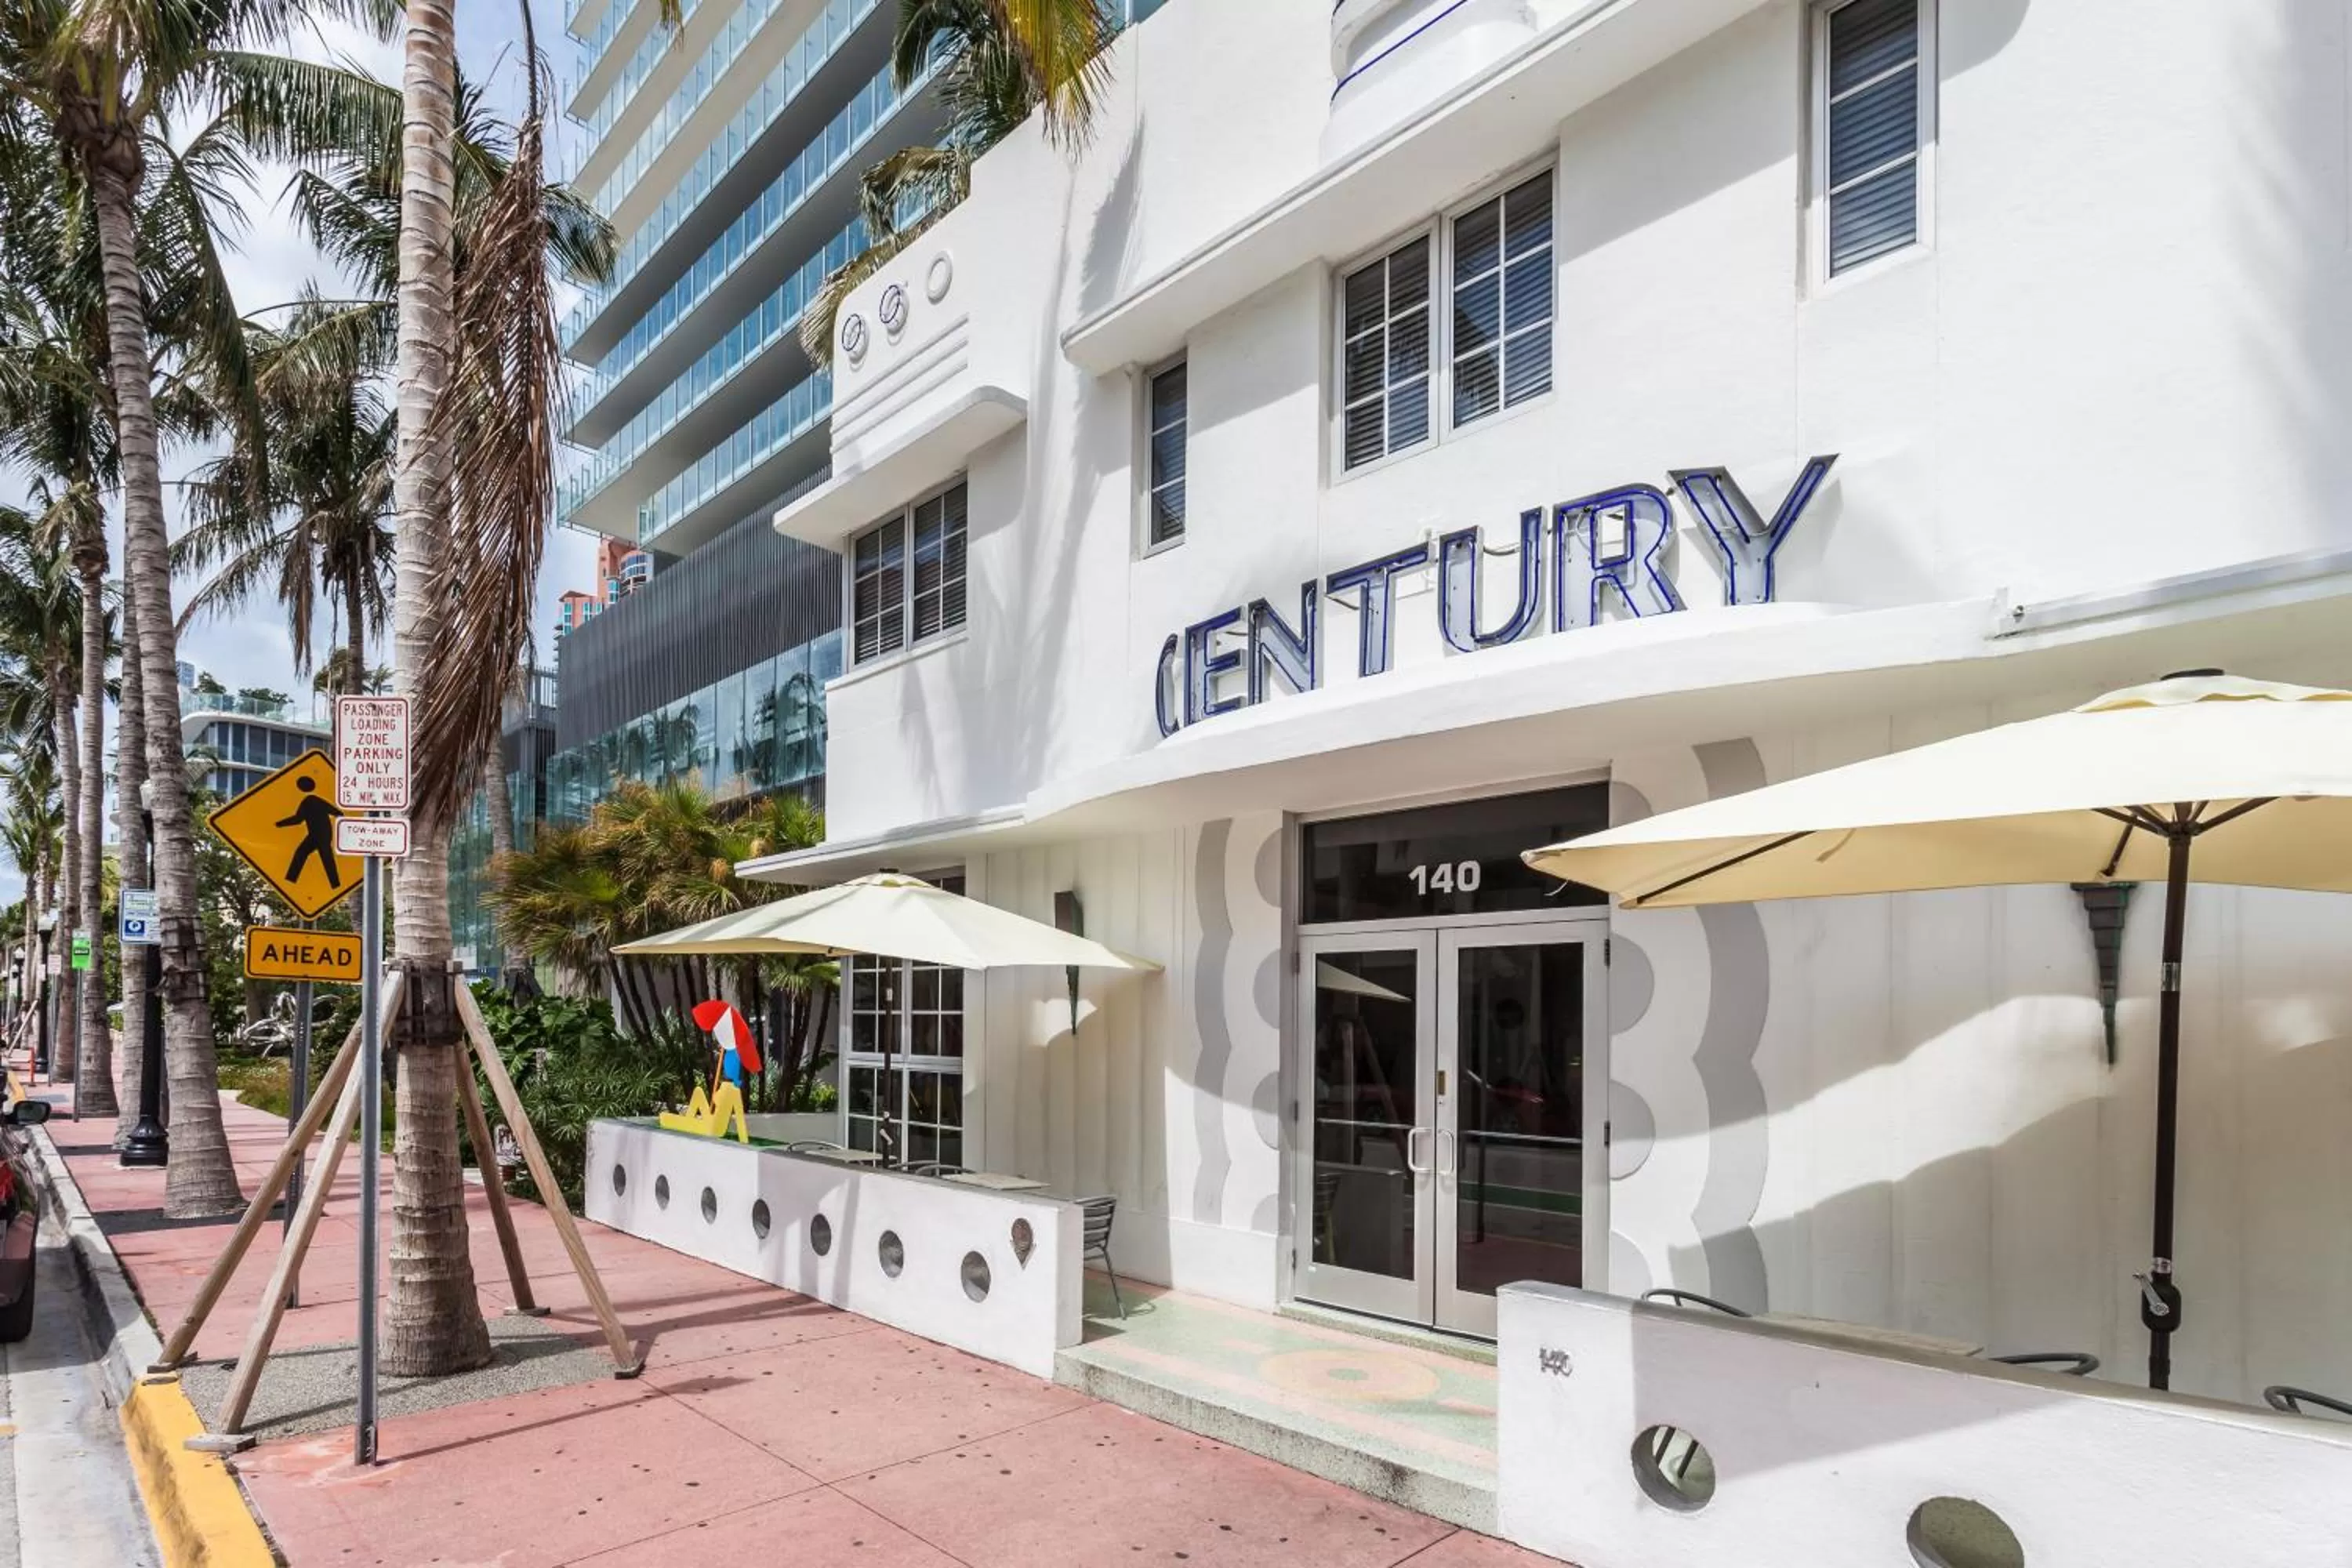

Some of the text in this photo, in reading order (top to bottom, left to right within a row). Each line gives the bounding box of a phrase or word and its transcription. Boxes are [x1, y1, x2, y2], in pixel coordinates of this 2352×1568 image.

[1155, 452, 1840, 739] CENTURY
[350, 718, 396, 731] LOADING
[358, 733, 389, 746] ZONE
[343, 747, 403, 760] PARKING
[356, 761, 390, 774] ONLY
[343, 775, 404, 789] 24 HOURS
[343, 790, 352, 804] 15
[347, 825, 399, 835] TOW-AWAY
[358, 838, 386, 848] ZONE
[1408, 860, 1481, 895] 140
[262, 943, 353, 967] AHEAD
